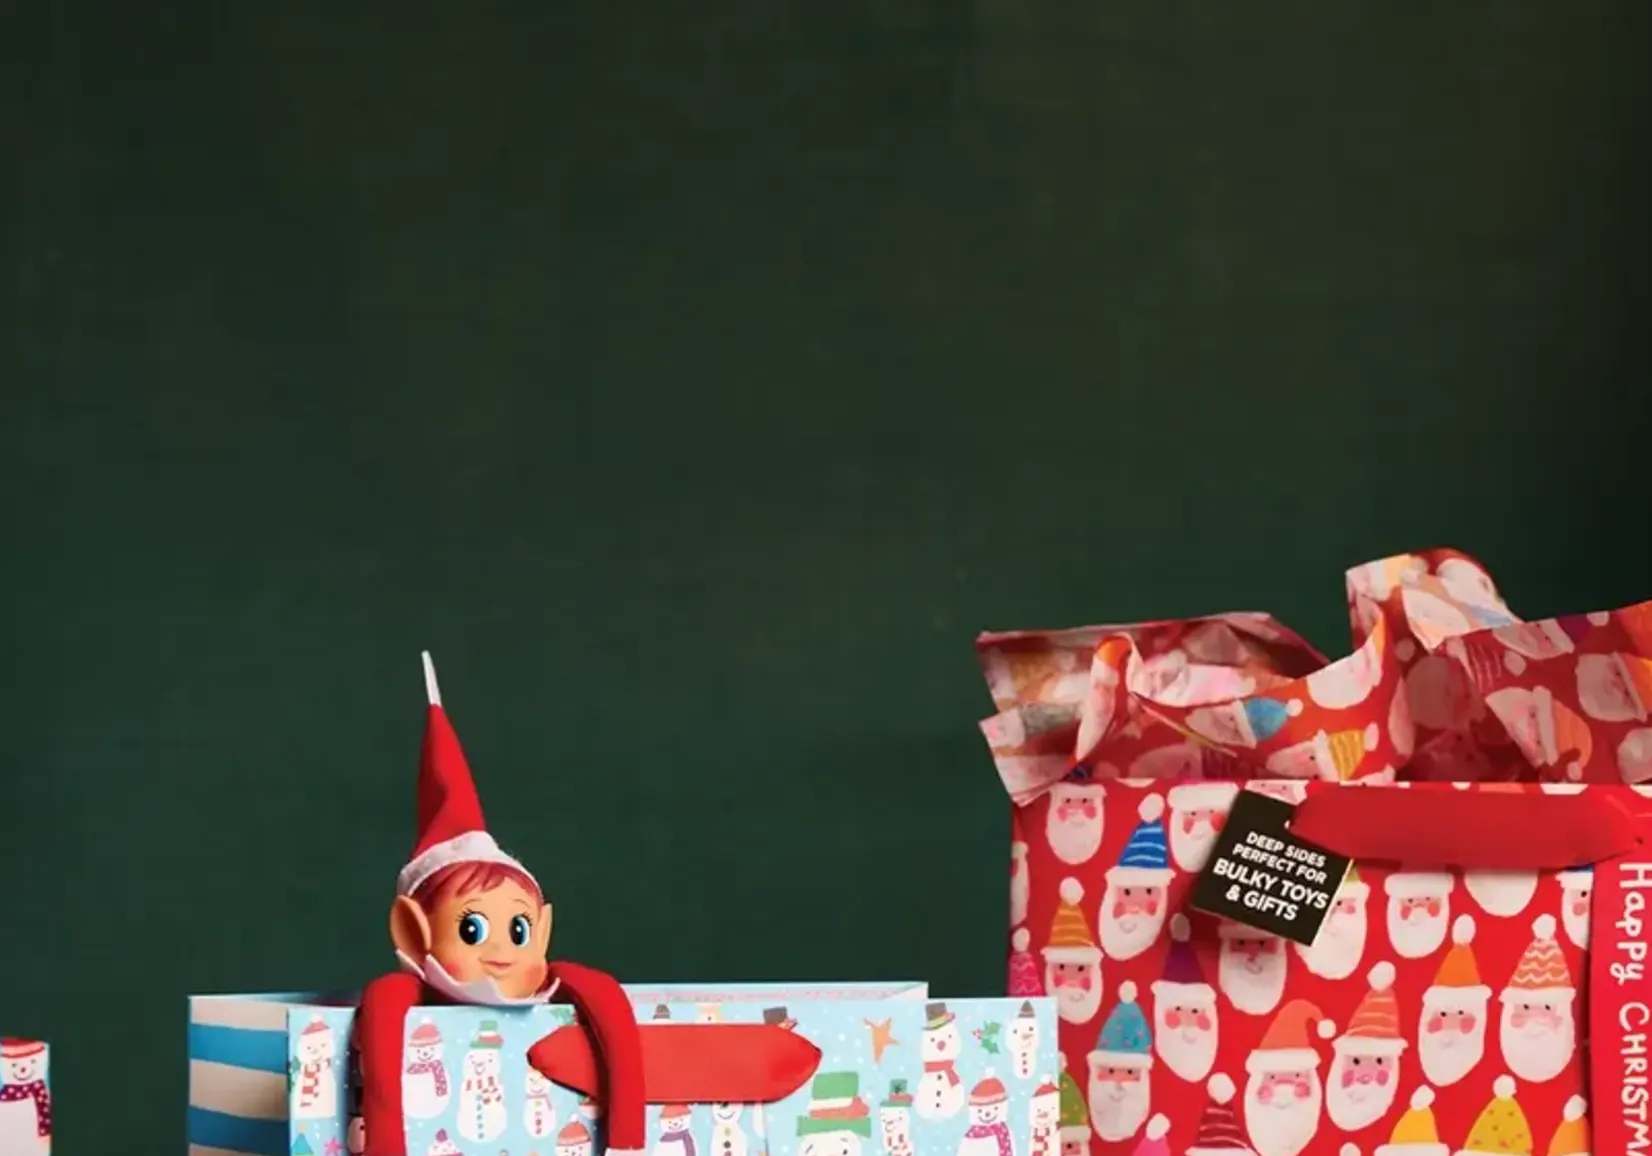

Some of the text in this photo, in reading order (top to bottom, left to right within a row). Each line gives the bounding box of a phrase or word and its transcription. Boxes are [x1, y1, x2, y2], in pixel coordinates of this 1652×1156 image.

[1231, 843, 1328, 885] PERFECT FOR
[1246, 831, 1327, 868] DEEP SIDES
[1212, 858, 1329, 910] BULKY TOYS
[1225, 884, 1299, 921] & GIFTS
[1609, 862, 1652, 986] Happy
